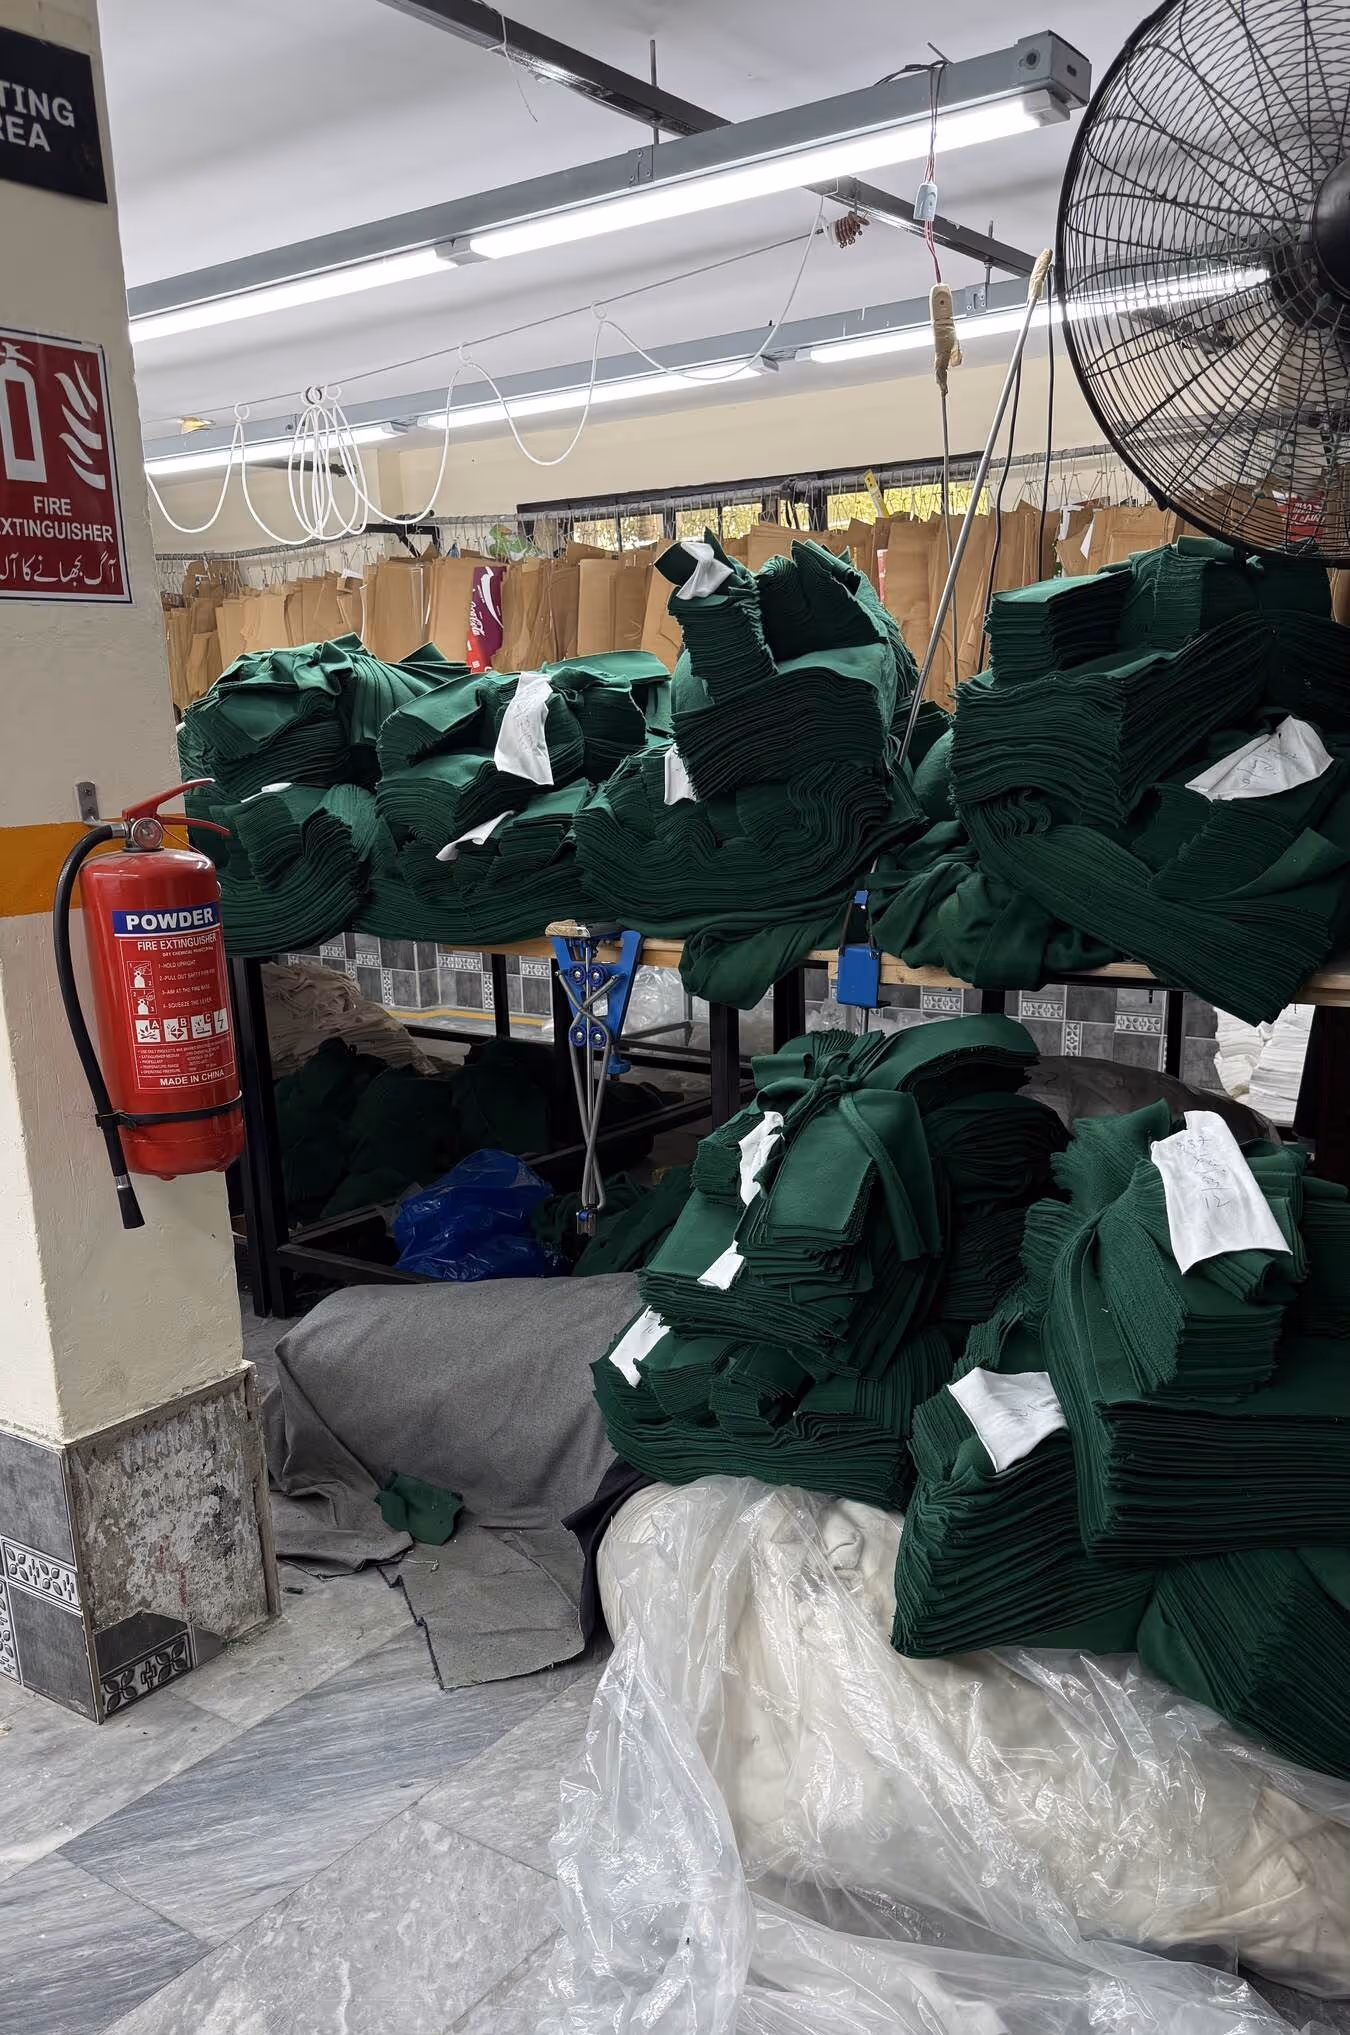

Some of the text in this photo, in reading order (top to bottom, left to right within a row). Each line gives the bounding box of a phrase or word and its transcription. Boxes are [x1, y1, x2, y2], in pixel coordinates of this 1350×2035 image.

[0, 114, 51, 152] EA
[33, 495, 72, 516] FIRE
[0, 517, 114, 543] XTINGUISHER
[84, 550, 117, 585] آگ
[126, 907, 214, 931] POWDER
[137, 941, 158, 951] FIRE
[160, 933, 217, 950] EXTINGUISHER
[151, 1020, 160, 1029] A
[180, 1017, 187, 1027] B
[205, 1013, 211, 1023] C
[160, 1069, 225, 1086] MADE IN CHINA
